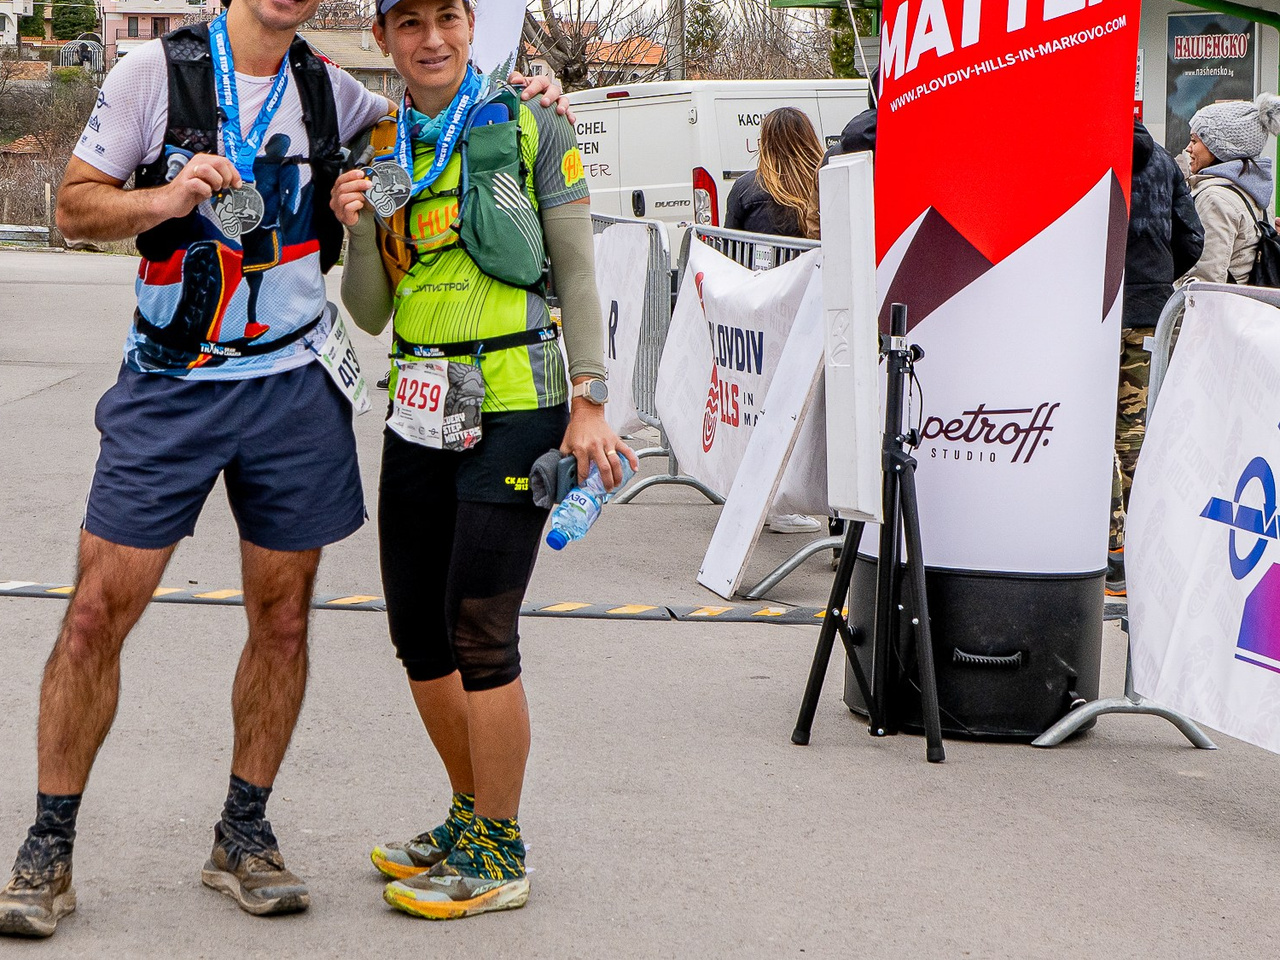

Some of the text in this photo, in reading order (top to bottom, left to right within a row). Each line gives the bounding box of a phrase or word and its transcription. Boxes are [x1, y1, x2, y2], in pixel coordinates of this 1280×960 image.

[1173, 33, 1248, 60] НАШЕНСКО
[889, 15, 1128, 113] WWW.PLOVDIV-HILLS-IN-MARKOVO.COM
[1184, 65, 1235, 78] www.nashensko.bg
[575, 121, 607, 136] CHEL
[738, 113, 768, 127] KACH
[578, 141, 599, 155] FEN
[654, 200, 691, 208] DUCATO
[708, 321, 764, 375] OVDIV
[337, 339, 360, 389] 413
[396, 378, 442, 413] 4259
[719, 380, 739, 428] LLS
[744, 391, 754, 407] IN
[914, 402, 1061, 464] petroff.
[931, 448, 996, 463] STUDIO
